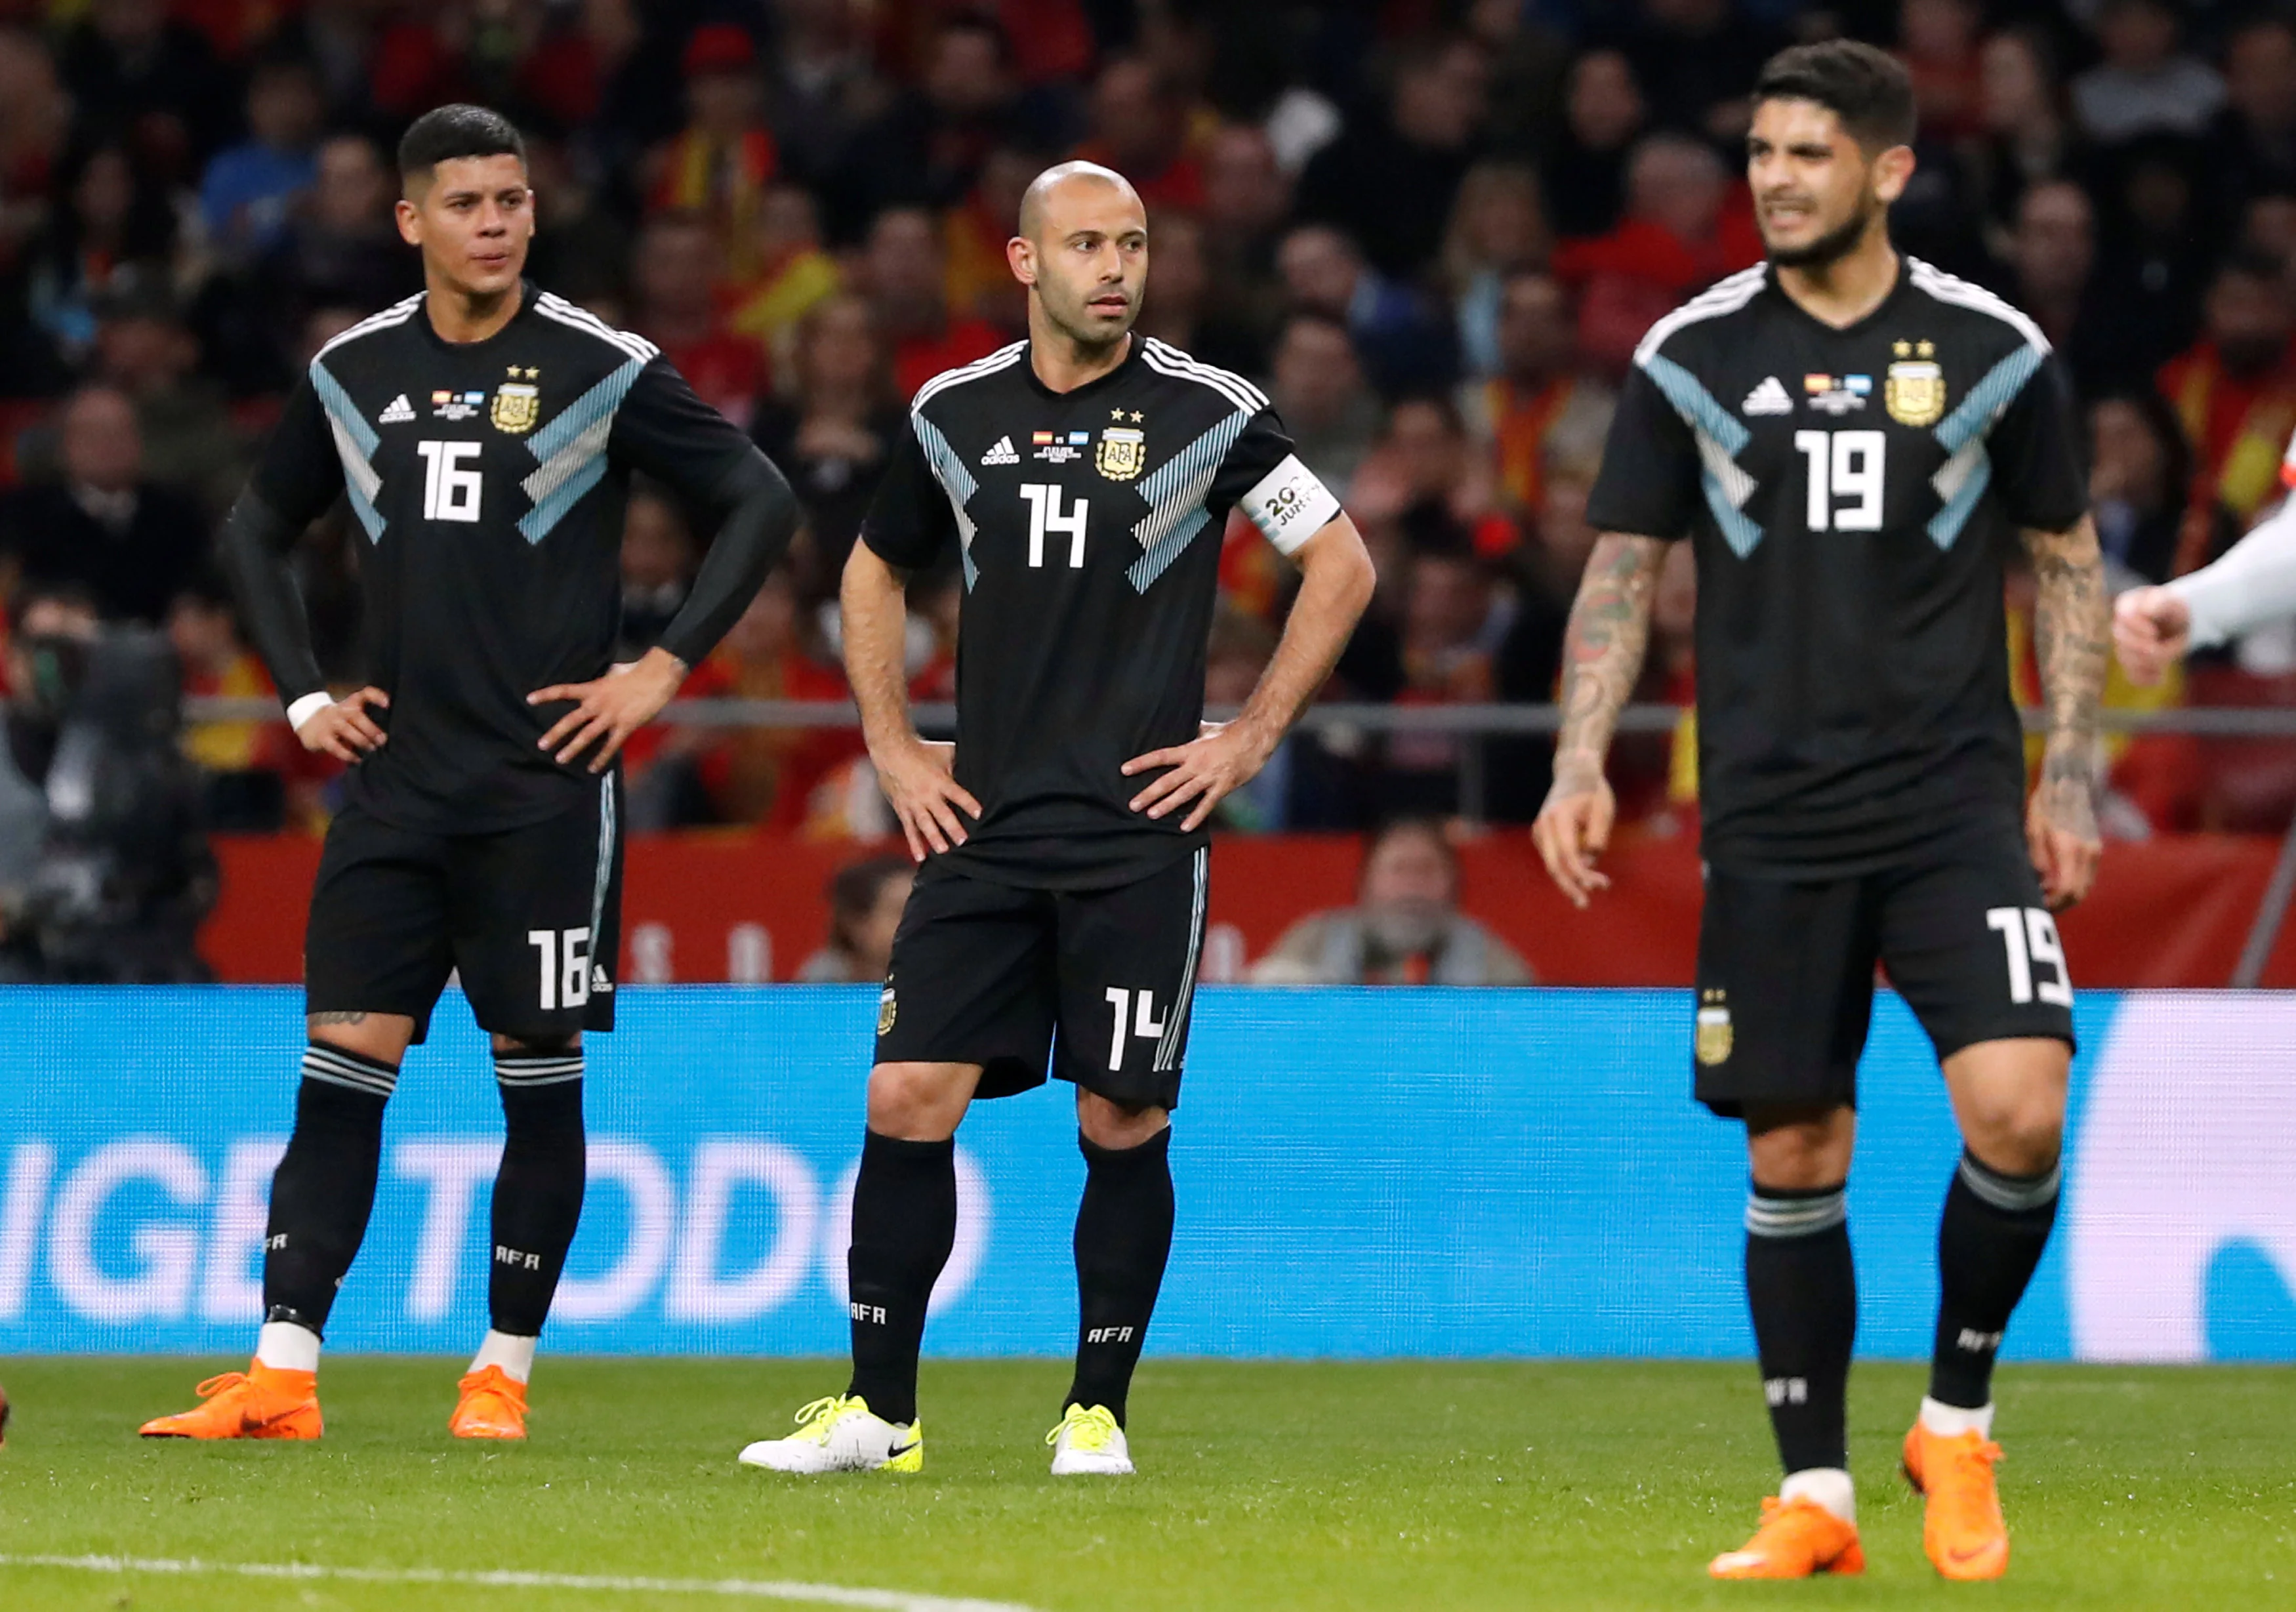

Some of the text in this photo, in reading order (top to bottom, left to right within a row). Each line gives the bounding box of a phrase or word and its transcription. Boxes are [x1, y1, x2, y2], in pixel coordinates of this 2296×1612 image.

[417, 440, 483, 522] 16
[981, 453, 1020, 465] adidas
[1794, 430, 1886, 531] 19
[1019, 484, 1090, 568] 14
[528, 926, 590, 1010] 16
[1986, 906, 2075, 1008] 19
[1105, 986, 1168, 1072] 14
[391, 1136, 994, 1323] TODO
[495, 1245, 541, 1271] AFA
[850, 1302, 886, 1325] AFA
[1087, 1326, 1134, 1344] AFA
